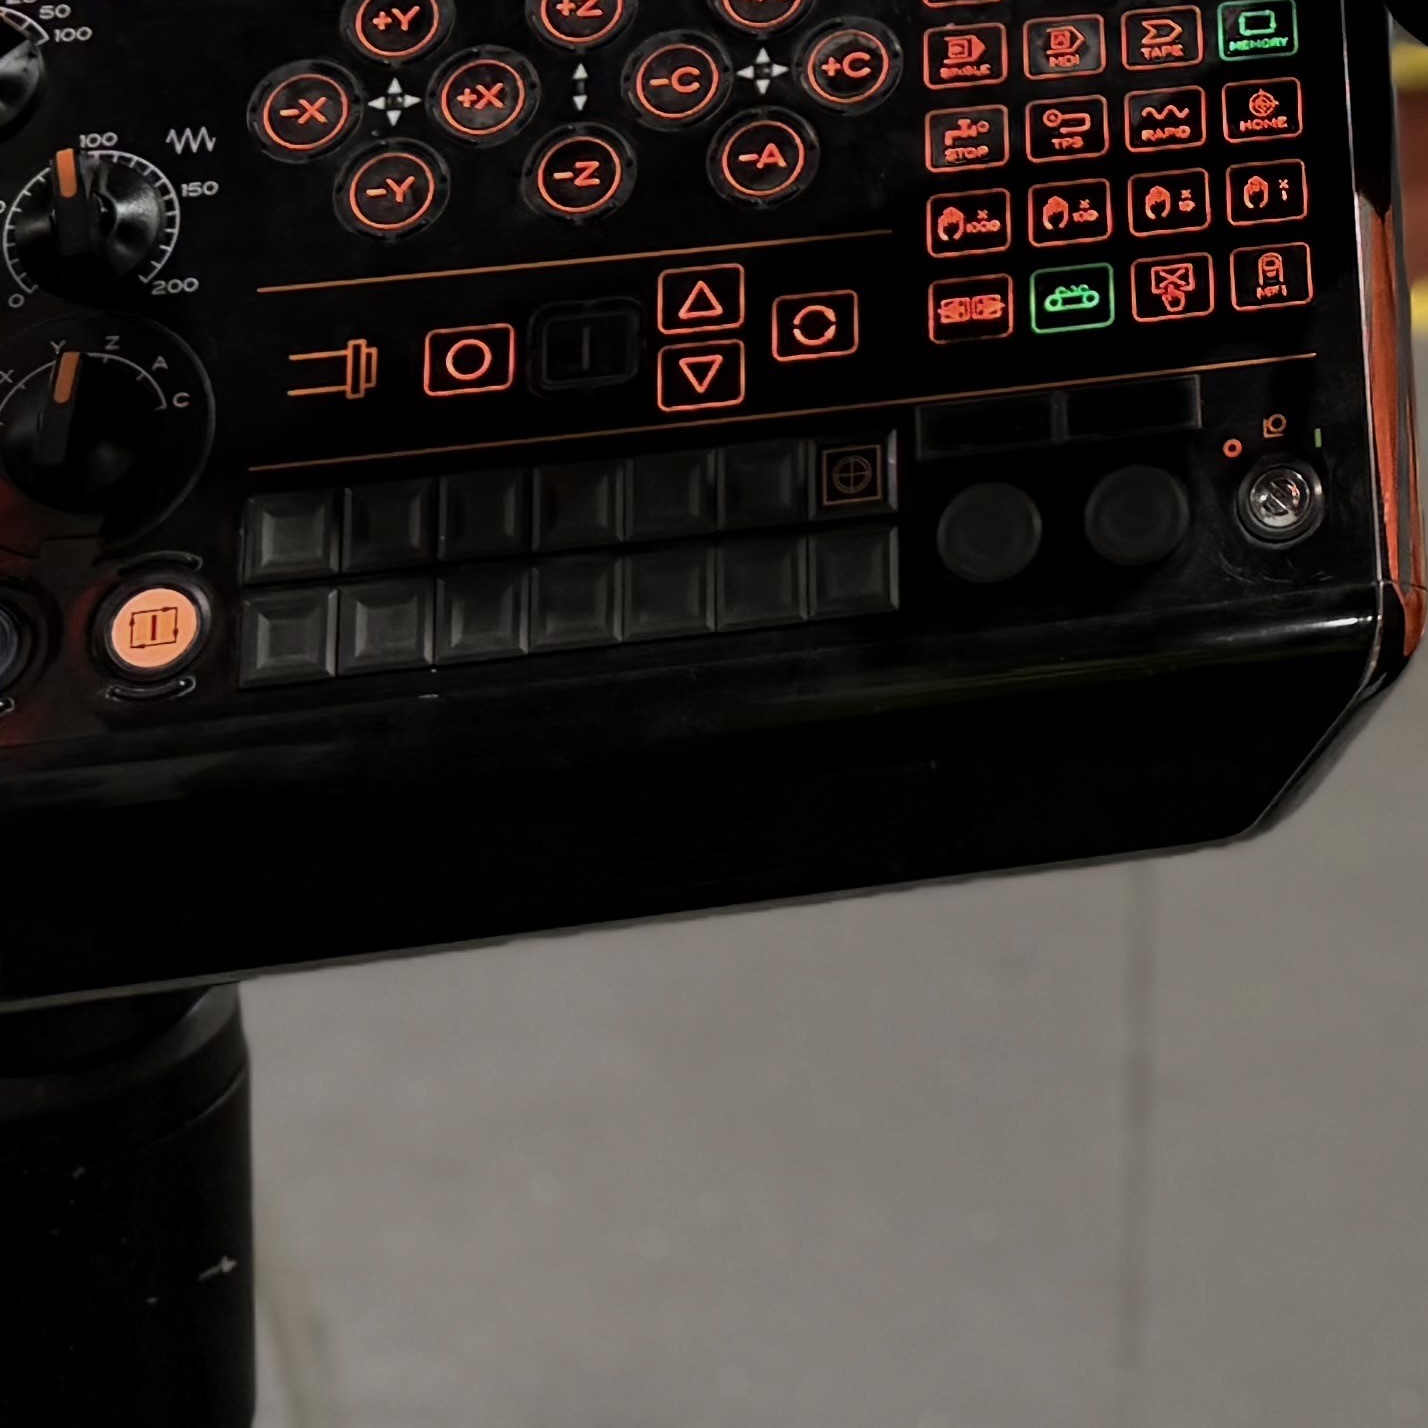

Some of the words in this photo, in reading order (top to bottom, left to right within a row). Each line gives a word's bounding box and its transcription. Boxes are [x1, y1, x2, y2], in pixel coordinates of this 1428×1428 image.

[39, 4, 71, 19] 50
[373, 5, 421, 32] +Y
[54, 27, 92, 42] 100
[1140, 44, 1184, 60] TAPE
[1229, 36, 1289, 52] MEMORY
[821, 51, 871, 78] +C
[650, 66, 700, 94] -C
[456, 82, 505, 111] +X
[279, 97, 328, 124] -X
[1239, 117, 1288, 133] HOME
[80, 132, 118, 148] 100
[1141, 126, 1191, 142] RAPID
[737, 142, 789, 169] -A
[944, 145, 989, 163] STOP
[553, 160, 601, 188] -Z
[181, 181, 219, 197] 150
[366, 175, 416, 203] -Y
[151, 278, 199, 295] 200
[8, 294, 25, 309] 0
[105, 335, 120, 350] Z
[152, 356, 168, 371] A
[173, 392, 190, 408] C
